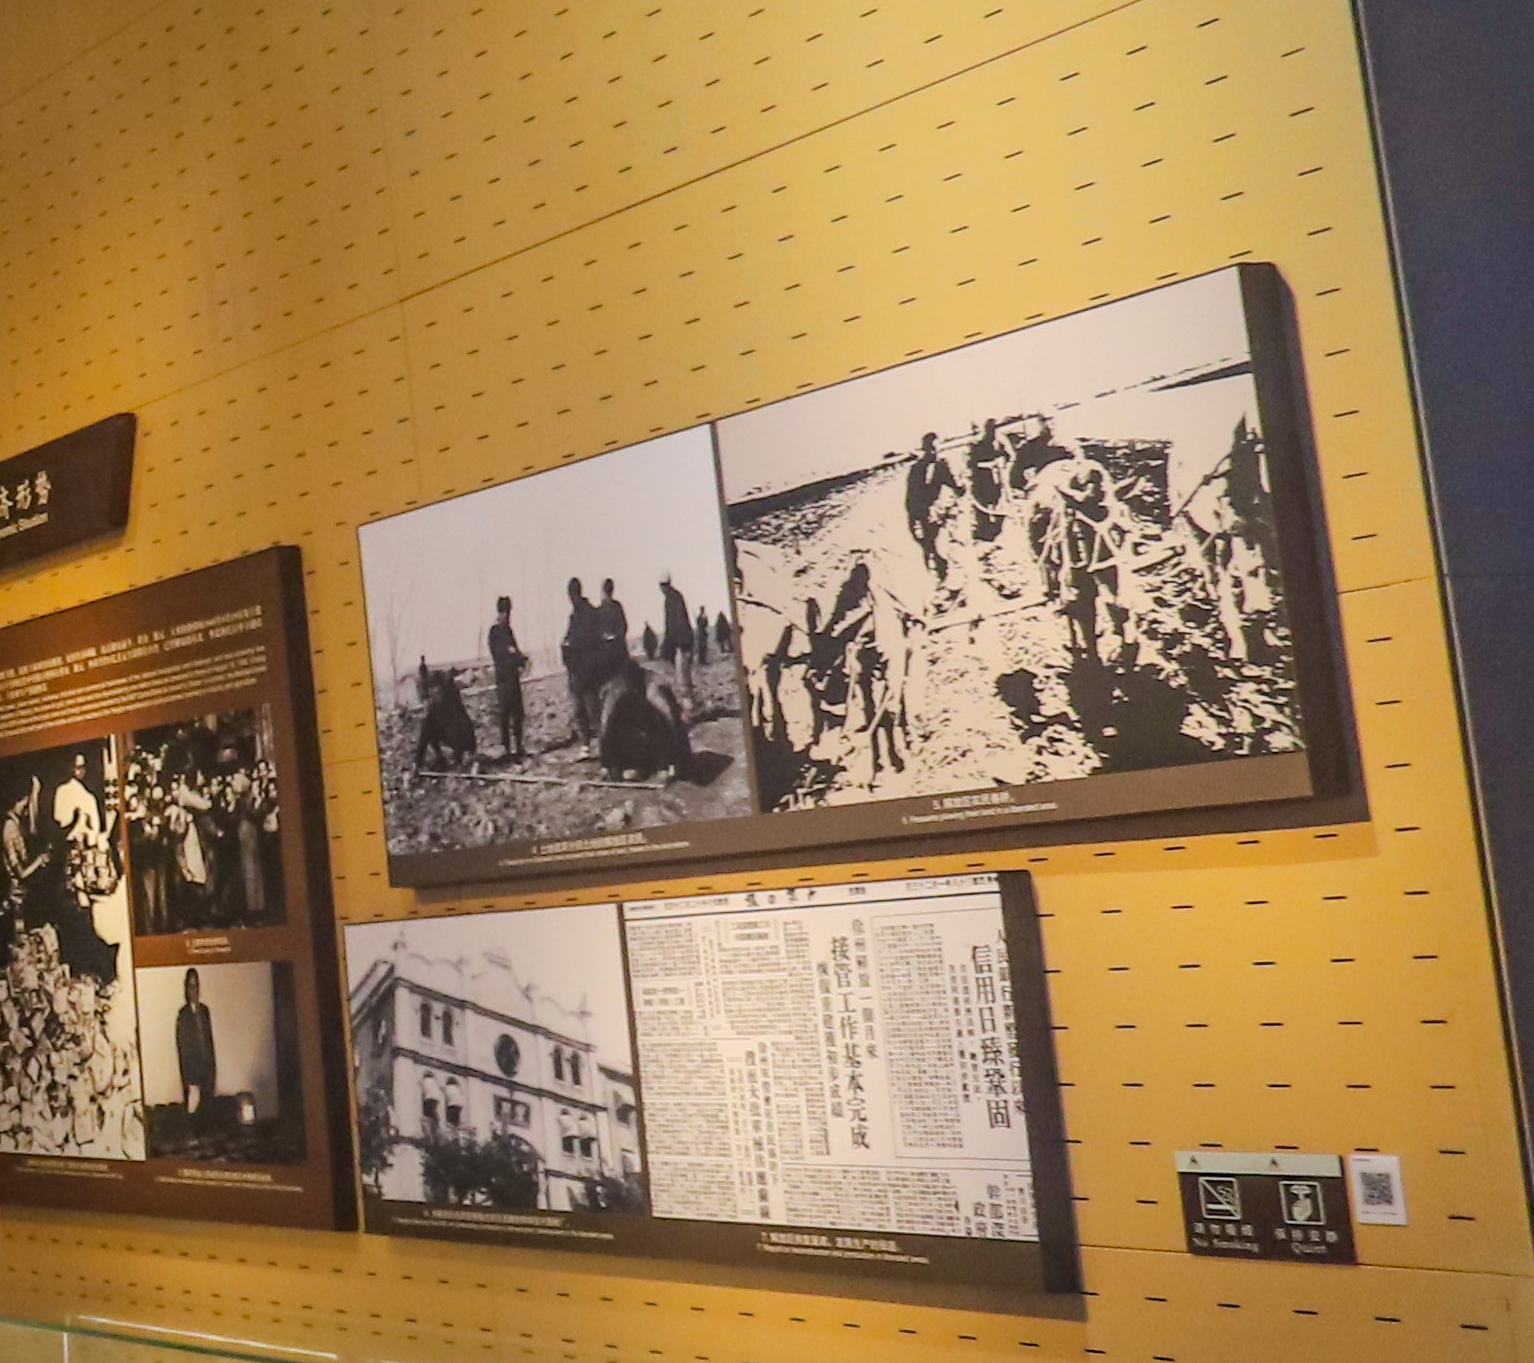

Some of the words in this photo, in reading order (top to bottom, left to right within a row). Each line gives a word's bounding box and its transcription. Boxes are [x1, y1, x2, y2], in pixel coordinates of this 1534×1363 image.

[18, 512, 49, 532] Situation
[830, 936, 871, 1150] 接管工作基本完成
